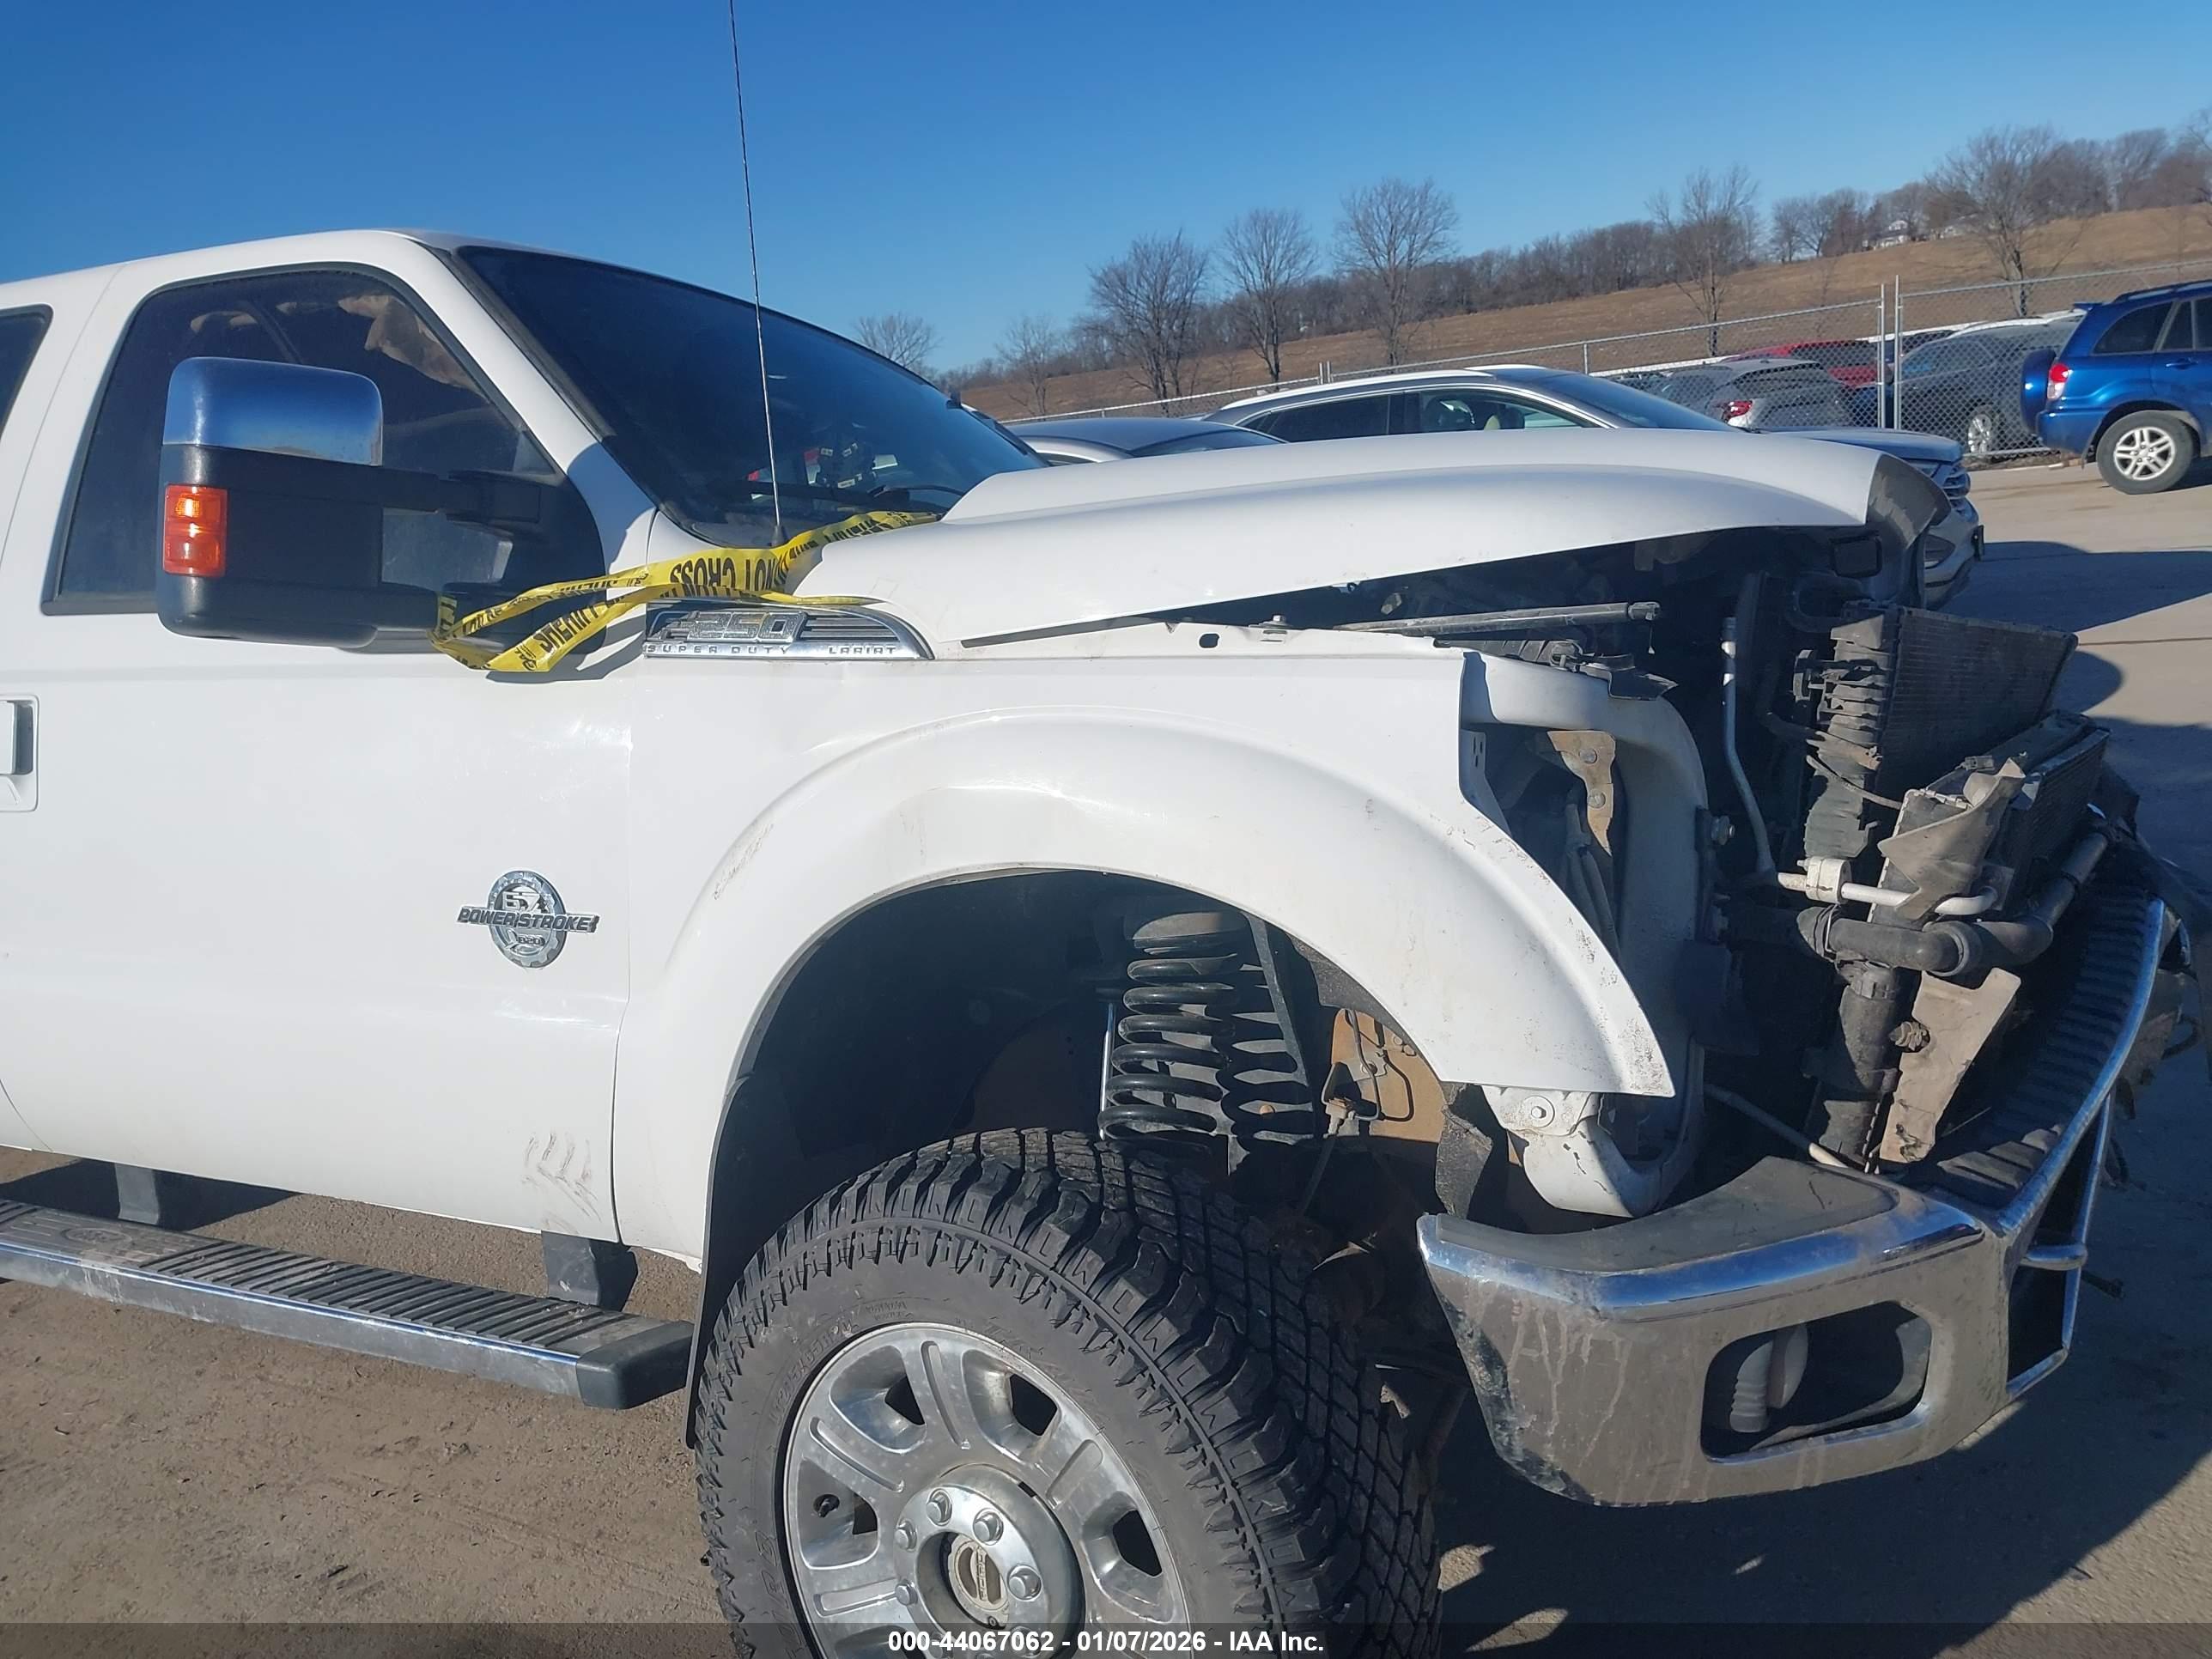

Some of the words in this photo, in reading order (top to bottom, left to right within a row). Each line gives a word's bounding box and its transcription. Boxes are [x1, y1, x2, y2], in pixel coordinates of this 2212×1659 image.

[670, 556, 736, 588] CROSS
[647, 644, 719, 654] SUPER
[731, 645, 789, 655] DUTY
[829, 646, 897, 655] LARIAT
